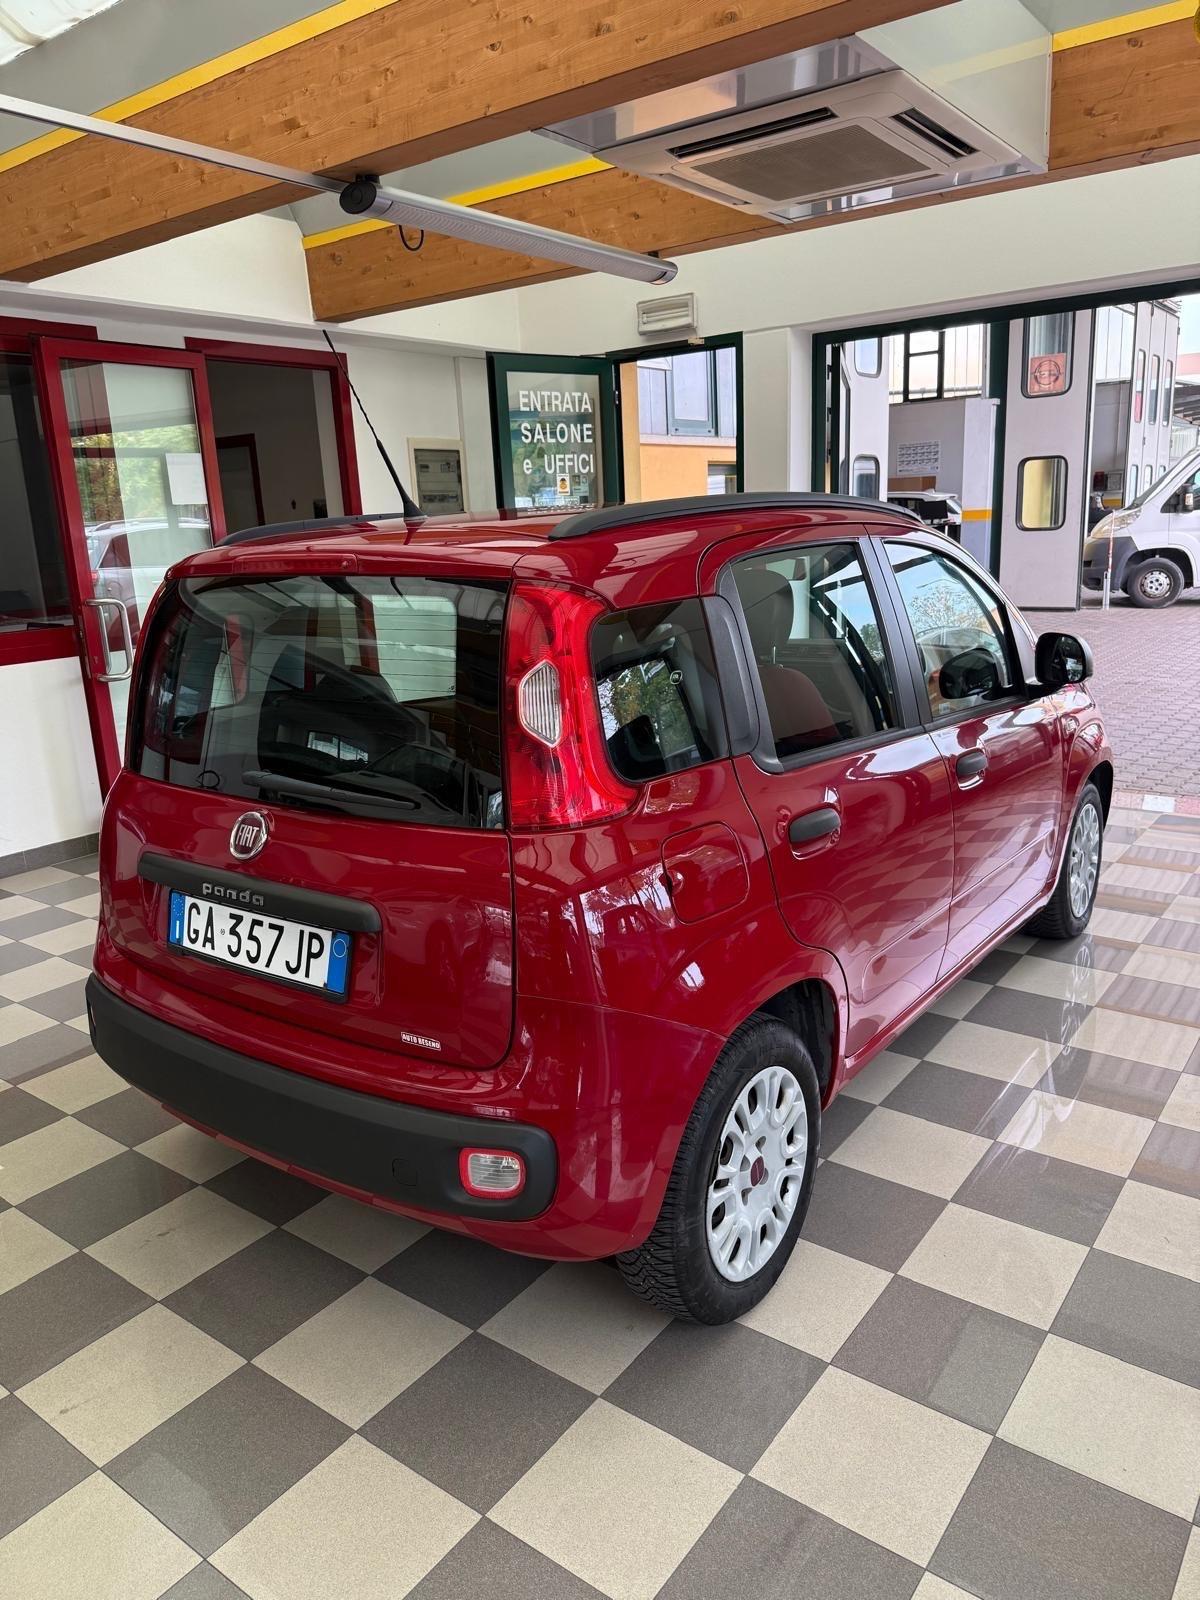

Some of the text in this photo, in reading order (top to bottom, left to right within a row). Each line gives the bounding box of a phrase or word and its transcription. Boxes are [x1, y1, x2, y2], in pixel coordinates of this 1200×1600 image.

[519, 390, 592, 413] ENTRATA
[521, 422, 593, 443] SALONE
[523, 454, 594, 475] e UFFICI
[236, 824, 260, 848] FIAT
[202, 882, 264, 906] panda
[402, 1033, 418, 1044] AUTO
